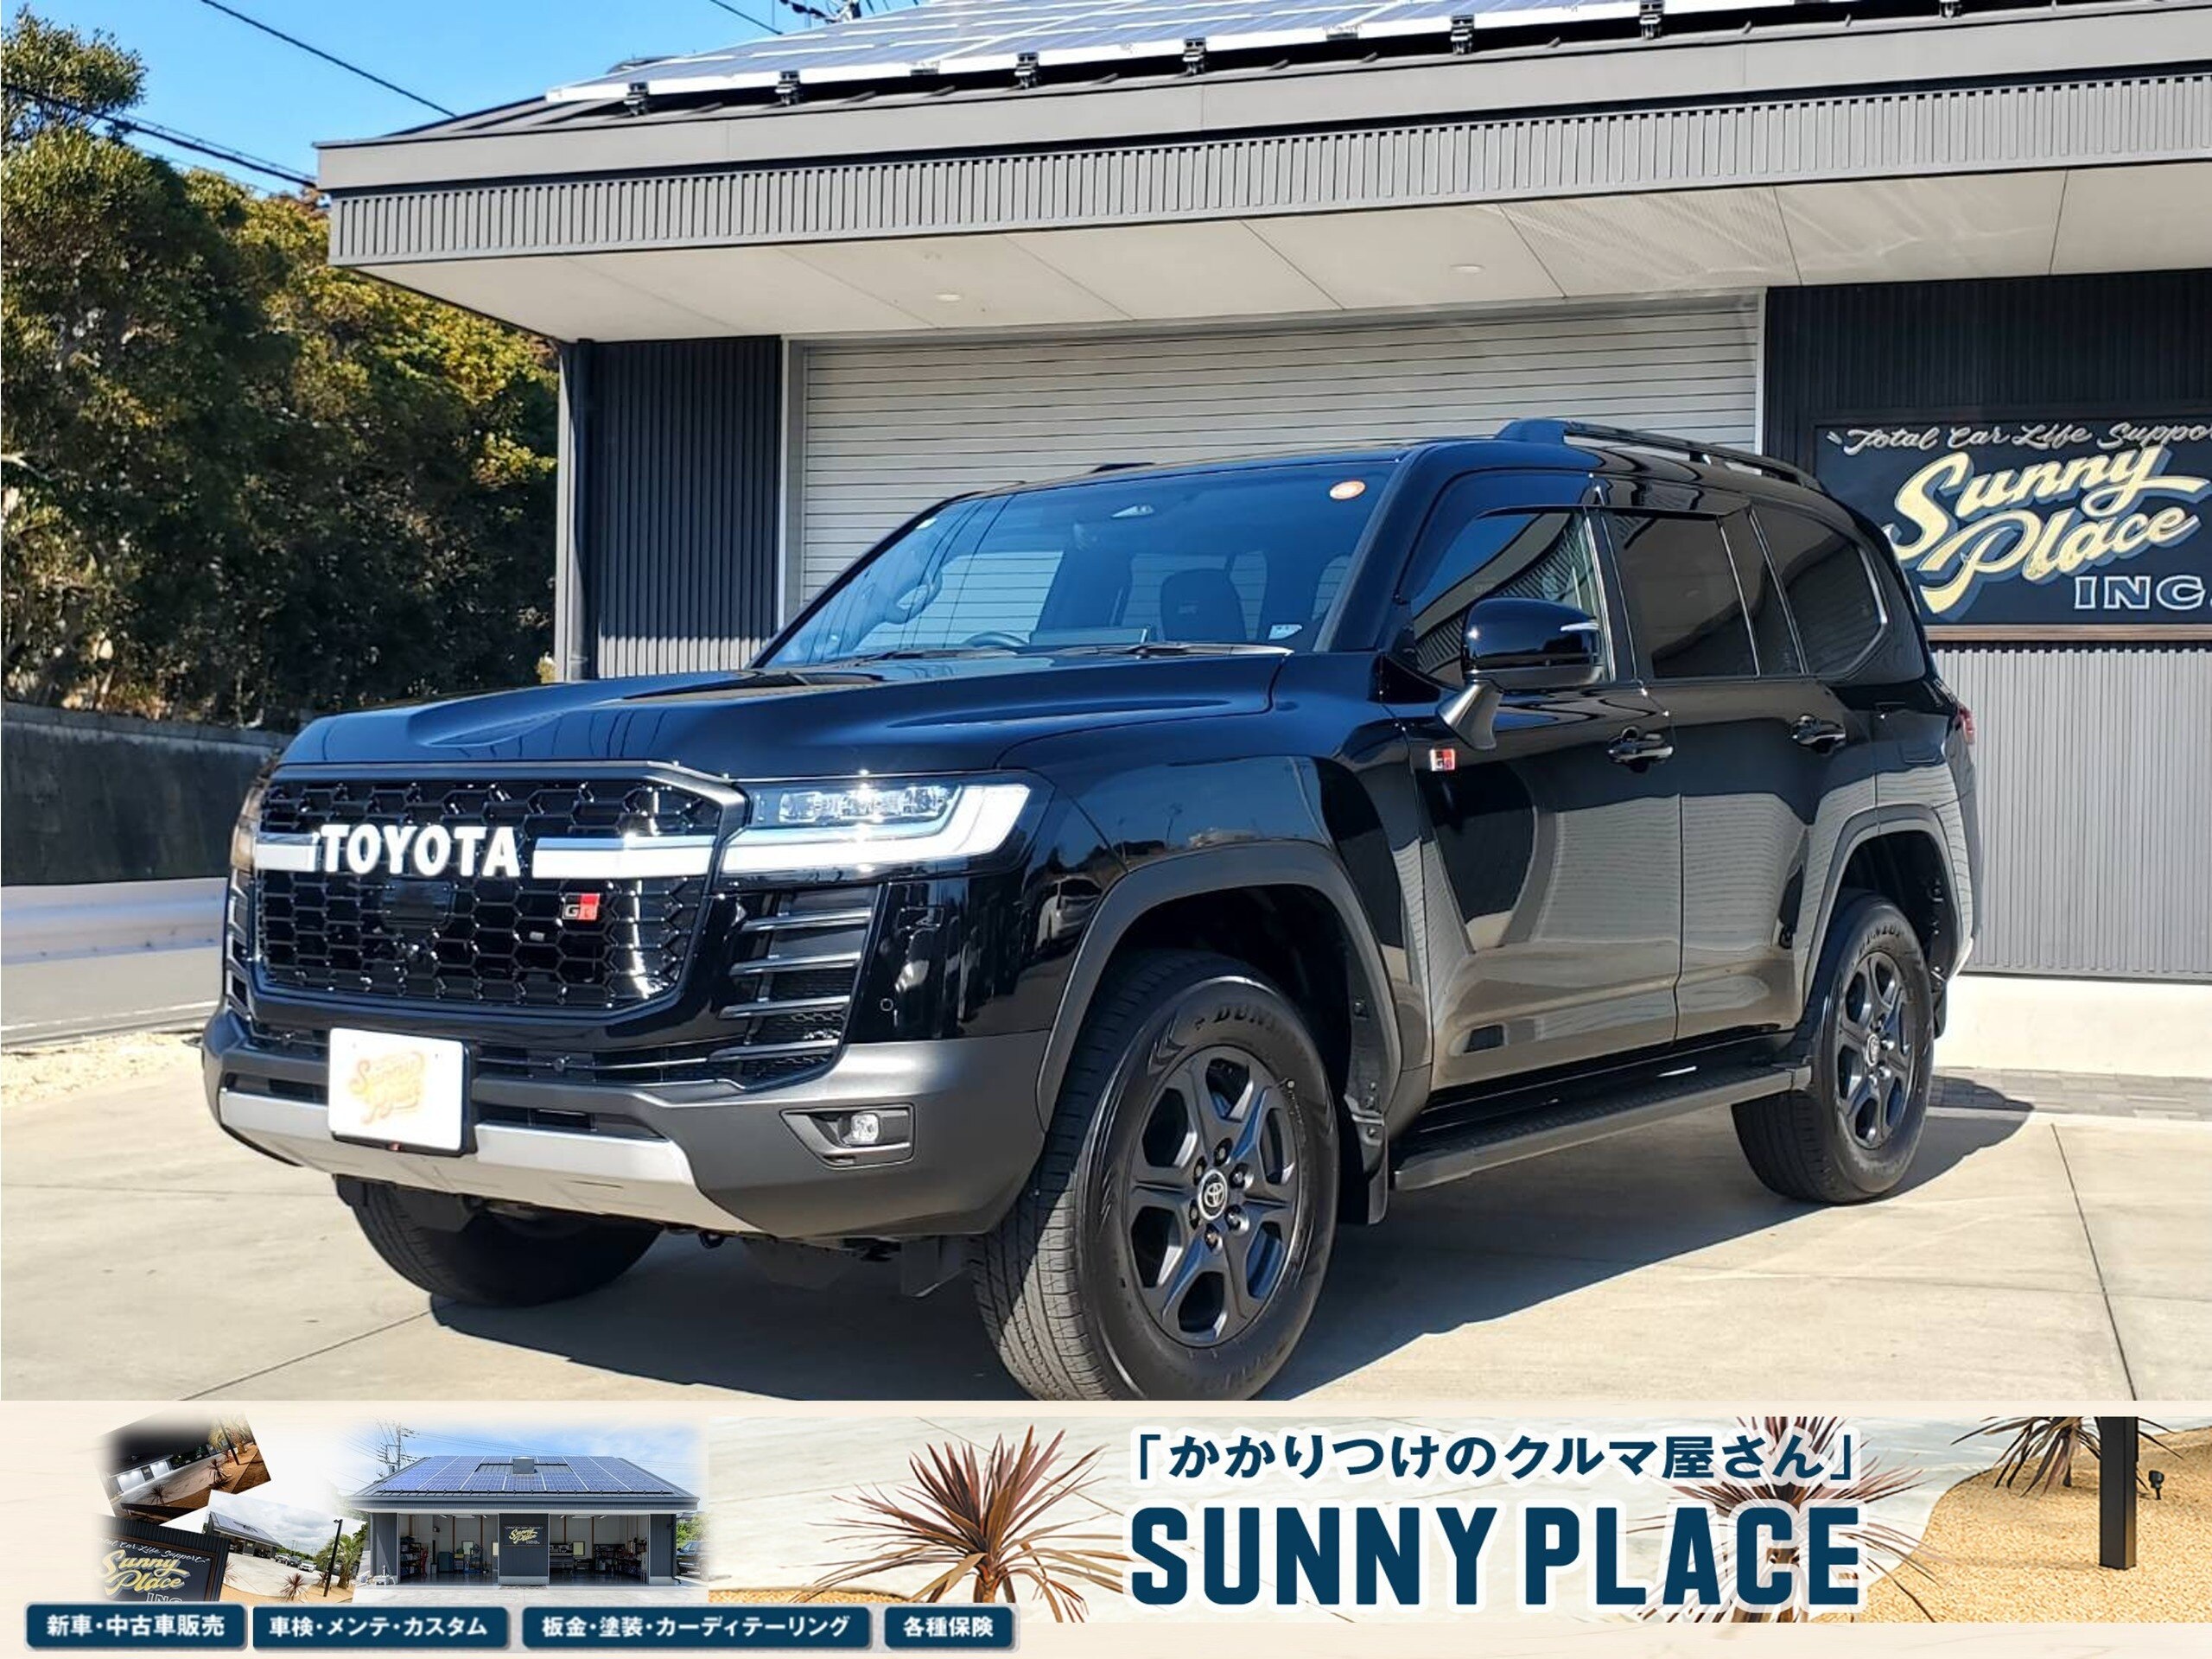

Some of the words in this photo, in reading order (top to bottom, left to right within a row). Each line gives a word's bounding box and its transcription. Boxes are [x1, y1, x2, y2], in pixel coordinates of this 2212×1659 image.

[1948, 426, 2011, 448] Car
[2012, 423, 2094, 450] Life
[2097, 421, 2212, 449] Suppo
[1882, 444, 2212, 563] Sunny
[1916, 506, 2202, 617] Place
[2075, 575, 2212, 610] INC
[321, 823, 521, 877] TOYOTA
